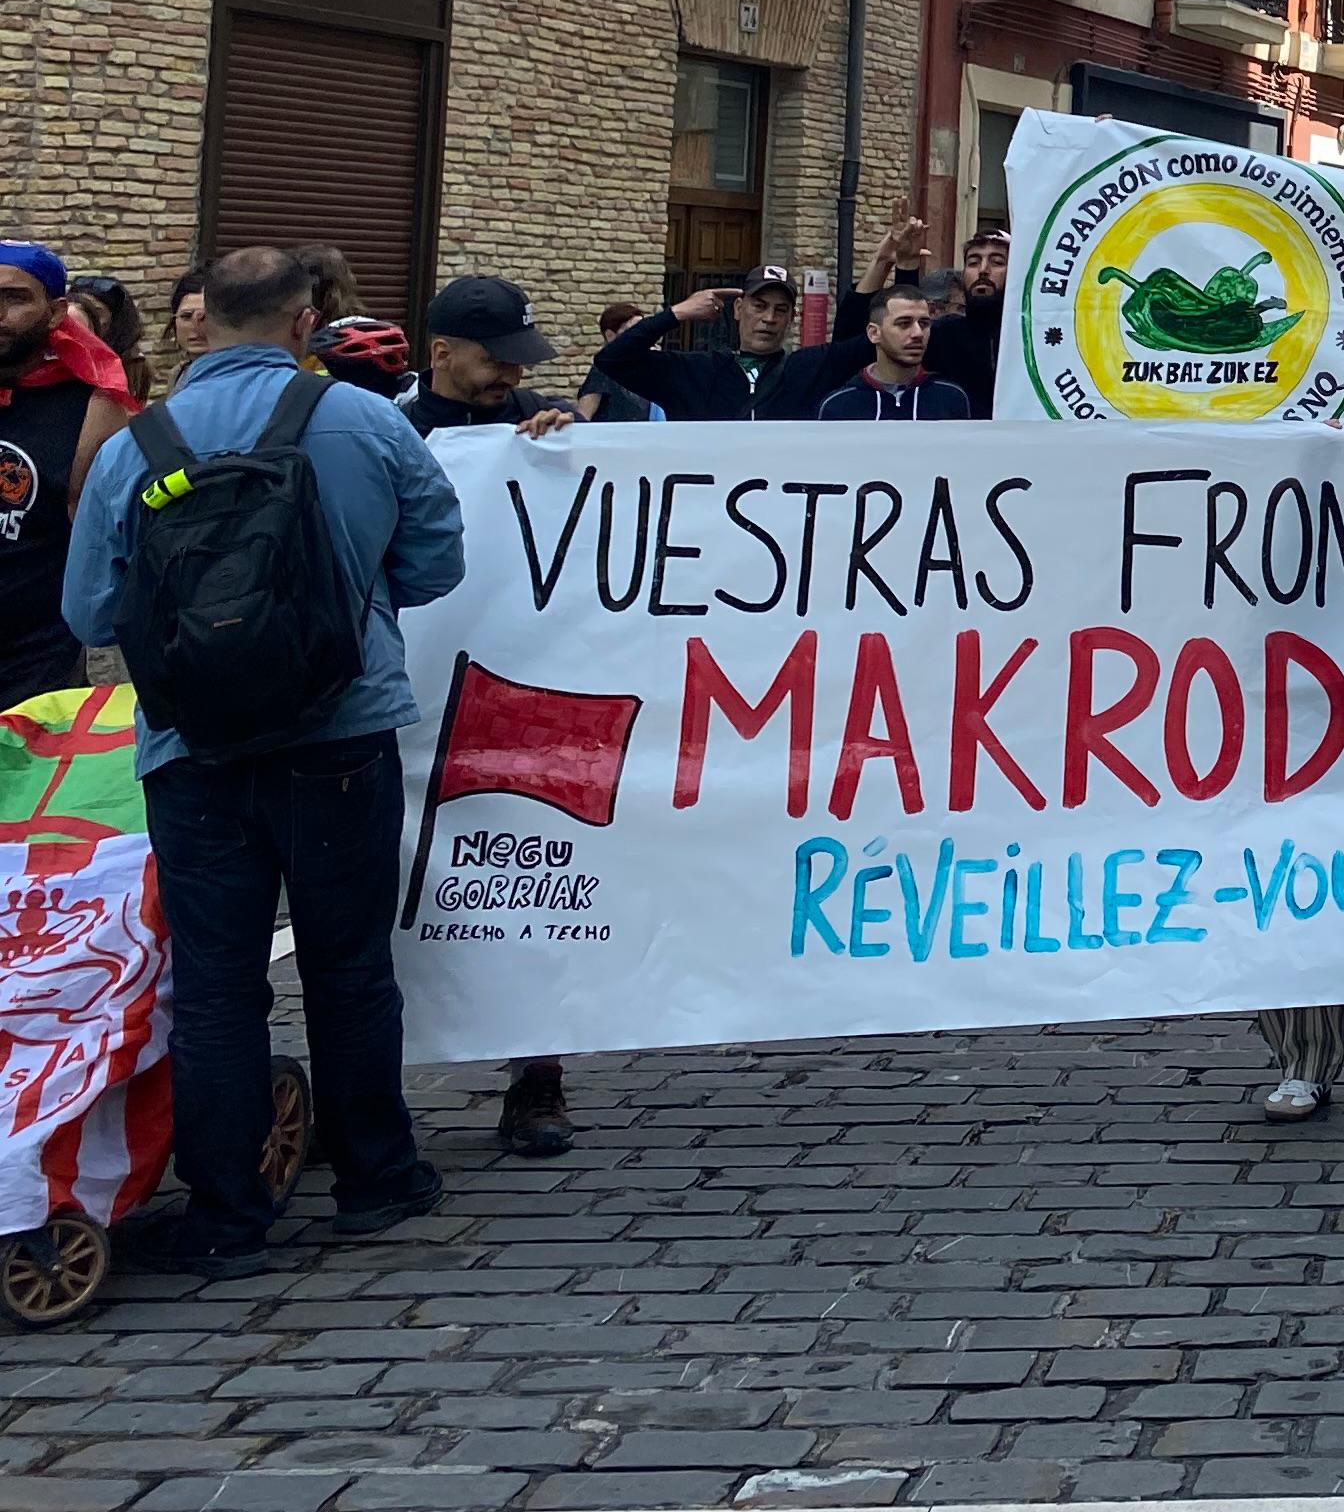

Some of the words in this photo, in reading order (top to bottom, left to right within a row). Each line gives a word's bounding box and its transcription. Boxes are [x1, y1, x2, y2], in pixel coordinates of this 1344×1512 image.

[1166, 152, 1239, 178] como
[1242, 154, 1281, 188] los
[1122, 361, 1163, 384] ZUK
[1166, 362, 1203, 384] BAI
[1254, 361, 1279, 383] EZ
[505, 464, 1035, 618] VUESTRAS
[420, 923, 505, 941] DERECHO
[519, 924, 533, 940] A
[544, 924, 610, 941] TECHO
